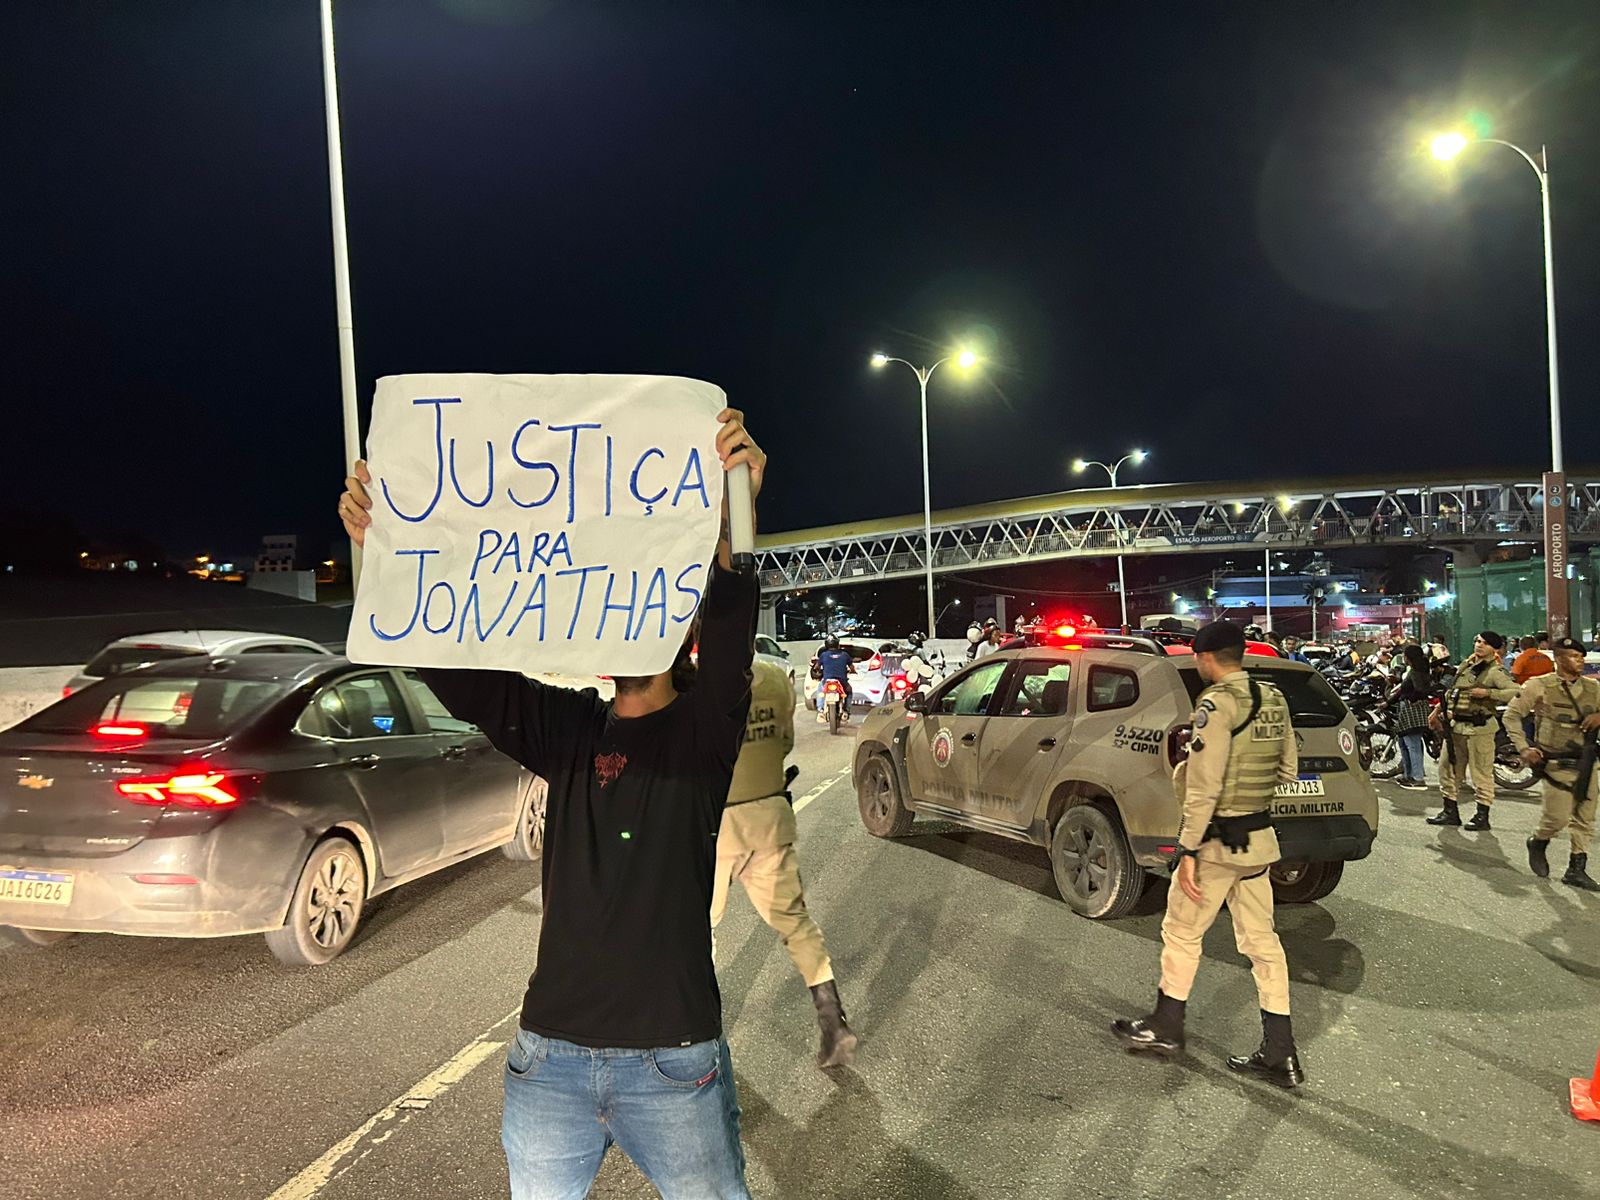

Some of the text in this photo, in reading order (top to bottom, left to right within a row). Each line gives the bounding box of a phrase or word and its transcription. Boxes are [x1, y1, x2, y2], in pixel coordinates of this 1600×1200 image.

[380, 397, 710, 523] JUSTIÇA
[470, 529, 573, 580] PARA
[1175, 535, 1235, 544] ESTAÇÃO AEROPORTO
[1551, 523, 1563, 579] AEROPORTO
[369, 549, 703, 643] JONATHAS
[1114, 724, 1164, 743] 9.5220
[1130, 742, 1159, 755] CIPM
[1300, 801, 1345, 814] MILITAR
